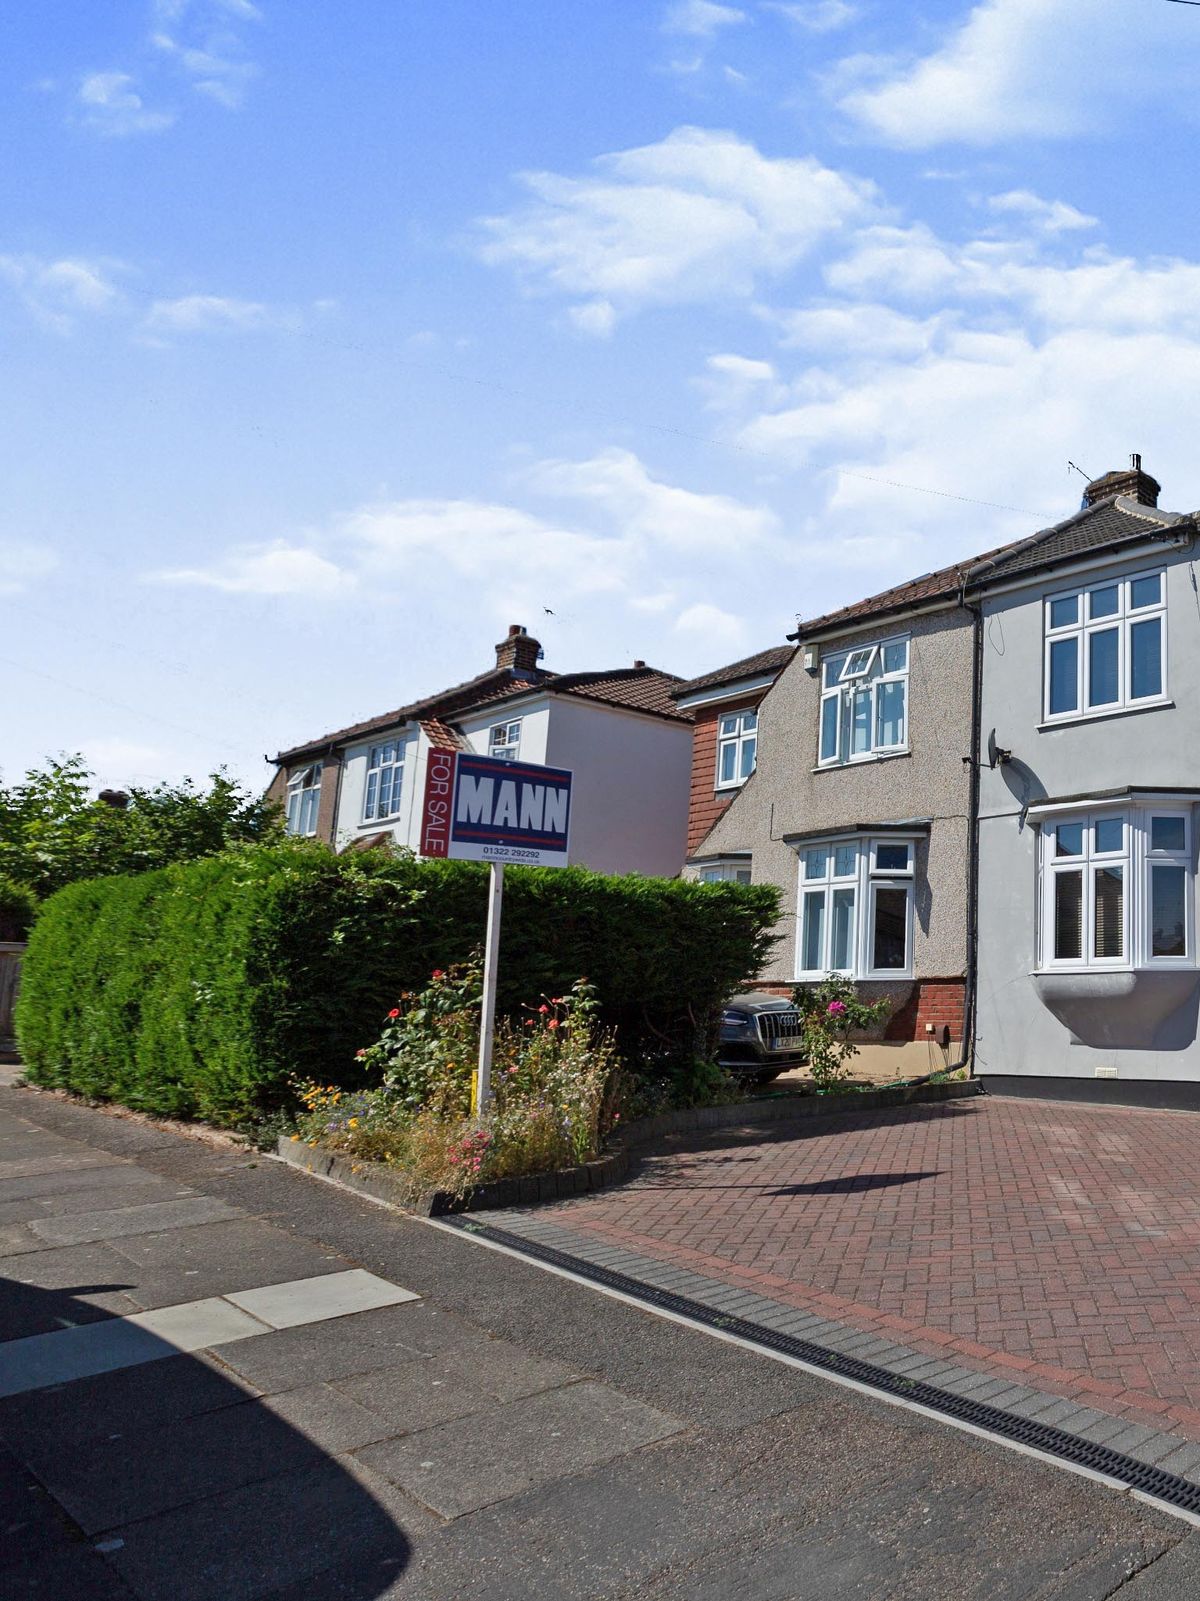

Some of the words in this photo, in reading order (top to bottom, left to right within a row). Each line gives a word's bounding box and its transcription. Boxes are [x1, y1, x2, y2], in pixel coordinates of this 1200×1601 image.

[429, 753, 451, 795] FOR
[425, 799, 448, 851] SALE
[456, 774, 569, 834] MANN
[483, 846, 509, 856] 01322
[511, 849, 540, 859] 292292
